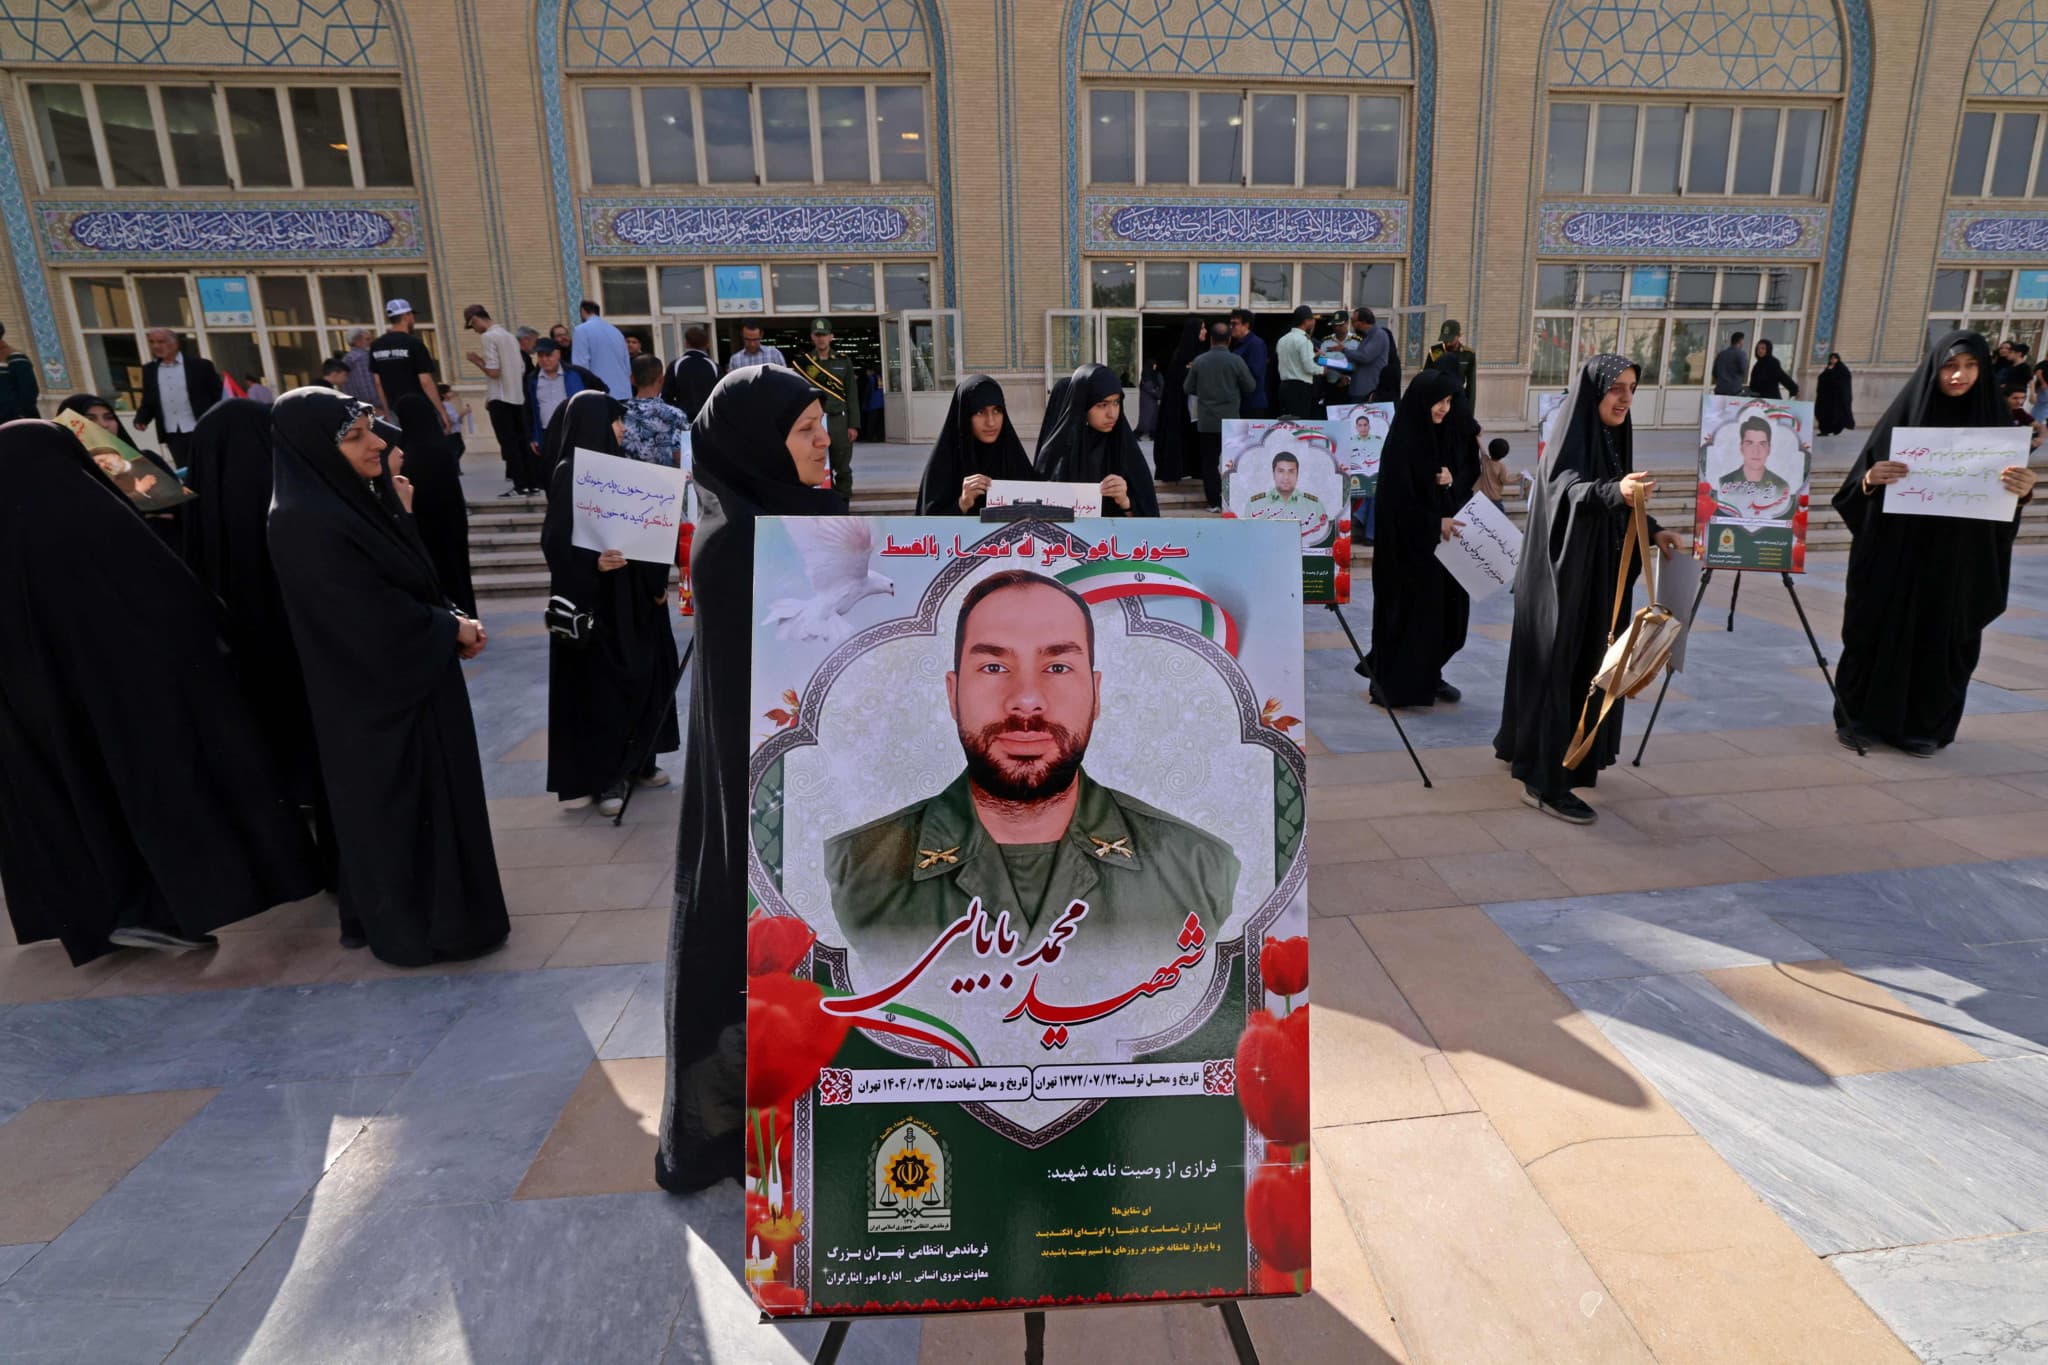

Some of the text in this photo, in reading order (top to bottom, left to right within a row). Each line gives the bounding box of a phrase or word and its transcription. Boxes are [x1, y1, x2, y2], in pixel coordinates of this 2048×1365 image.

[1016, 899, 1089, 968] محمد
[1002, 911, 1208, 1051] شهید
[979, 1077, 997, 1091] محل
[1007, 1076, 1028, 1091] تاریخ
[1035, 1073, 1058, 1090] تهران
[1145, 1072, 1170, 1085] محل
[1172, 1075, 1178, 1085] و
[1179, 1071, 1199, 1085] تاریخ
[858, 1078, 881, 1093] تهران
[1000, 1081, 1005, 1091] و
[1047, 1159, 1217, 1182] فرازی از وصیت نامه شهید:
[827, 1241, 989, 1262] فرماندهی انتظامی تهران بزرگ
[826, 1272, 862, 1286] ایثارگران
[863, 1272, 881, 1285] امور
[882, 1271, 902, 1284] اداره
[914, 1270, 939, 1283] انسانی
[940, 1269, 962, 1282] نیروی
[963, 1268, 989, 1280] معاونت
